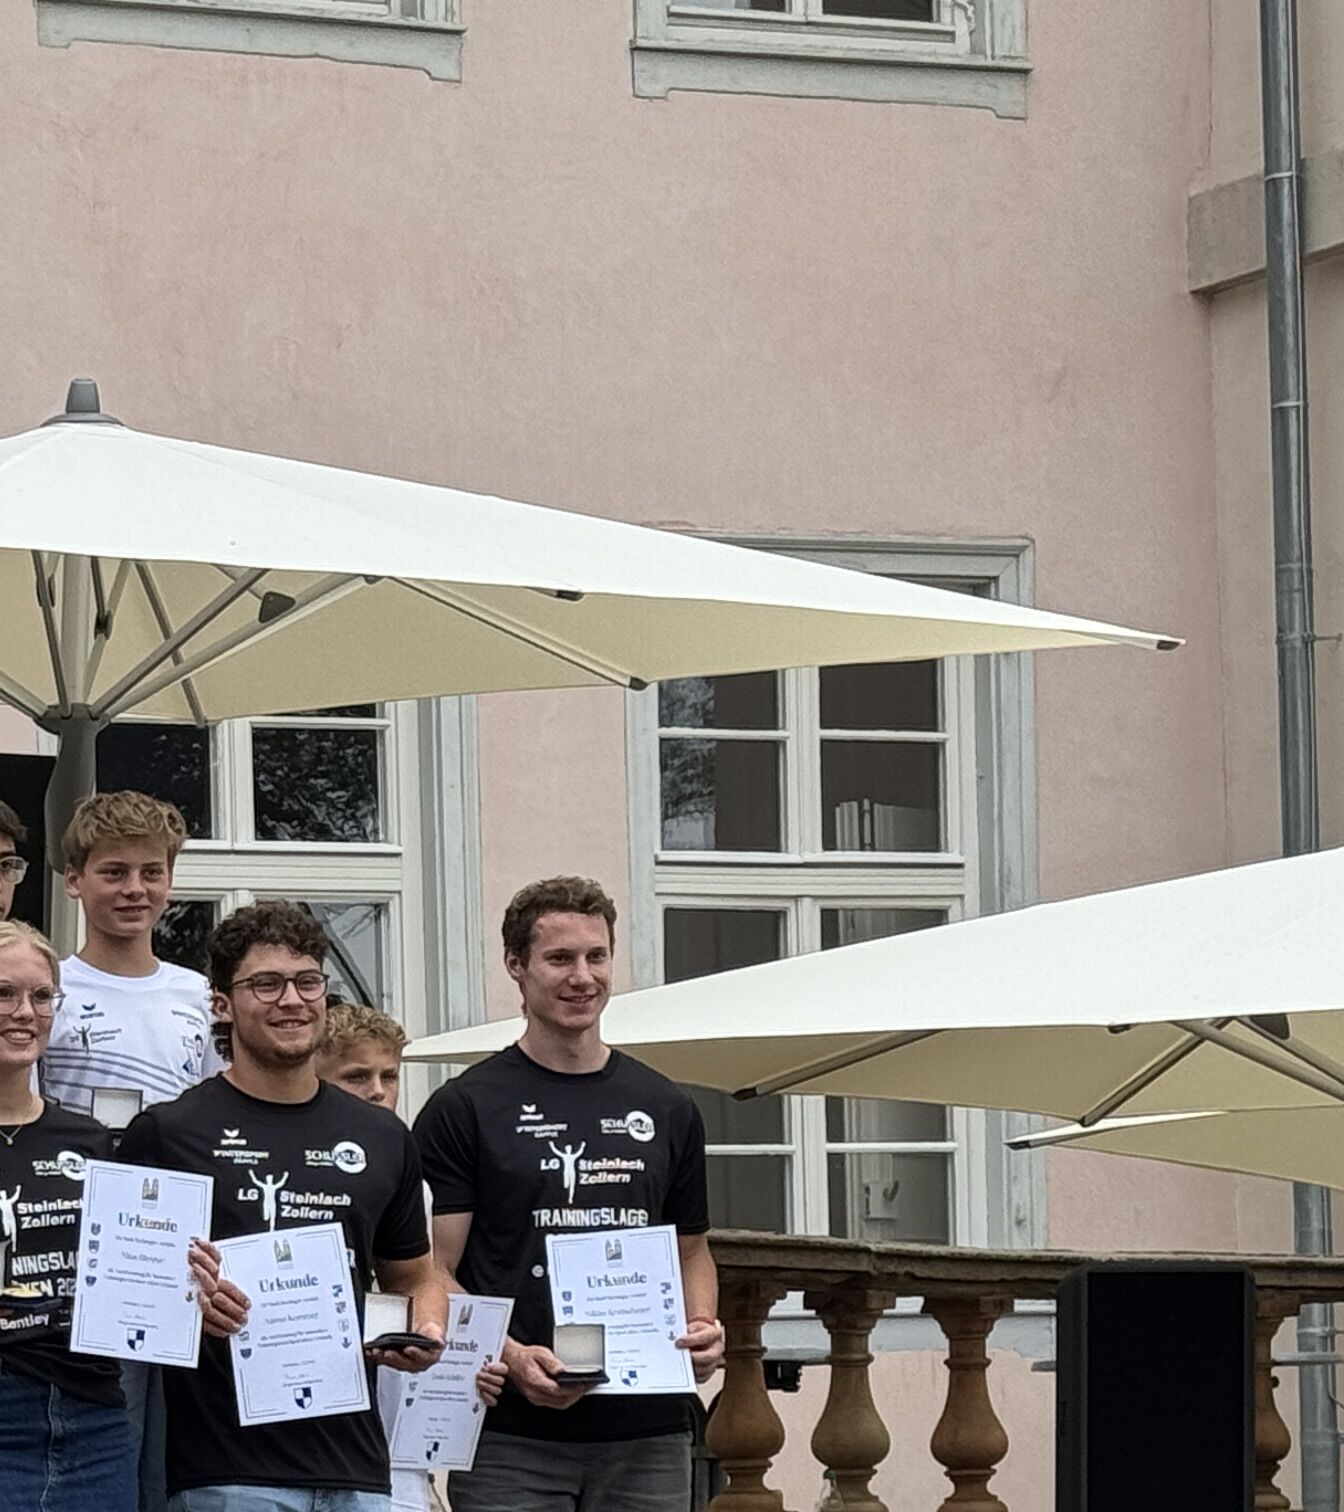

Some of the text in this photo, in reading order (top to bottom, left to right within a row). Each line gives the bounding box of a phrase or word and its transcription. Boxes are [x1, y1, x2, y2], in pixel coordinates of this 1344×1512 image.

[540, 1157, 645, 1172] LG Steinlach
[579, 1171, 632, 1185] Zollern
[237, 1188, 352, 1206] LG Steinlach
[281, 1205, 334, 1220] Zollern
[21, 1214, 76, 1230] Zollern
[118, 1211, 178, 1233] Urkunde
[259, 1273, 320, 1293] Urkunde
[586, 1271, 648, 1288] Urkunde
